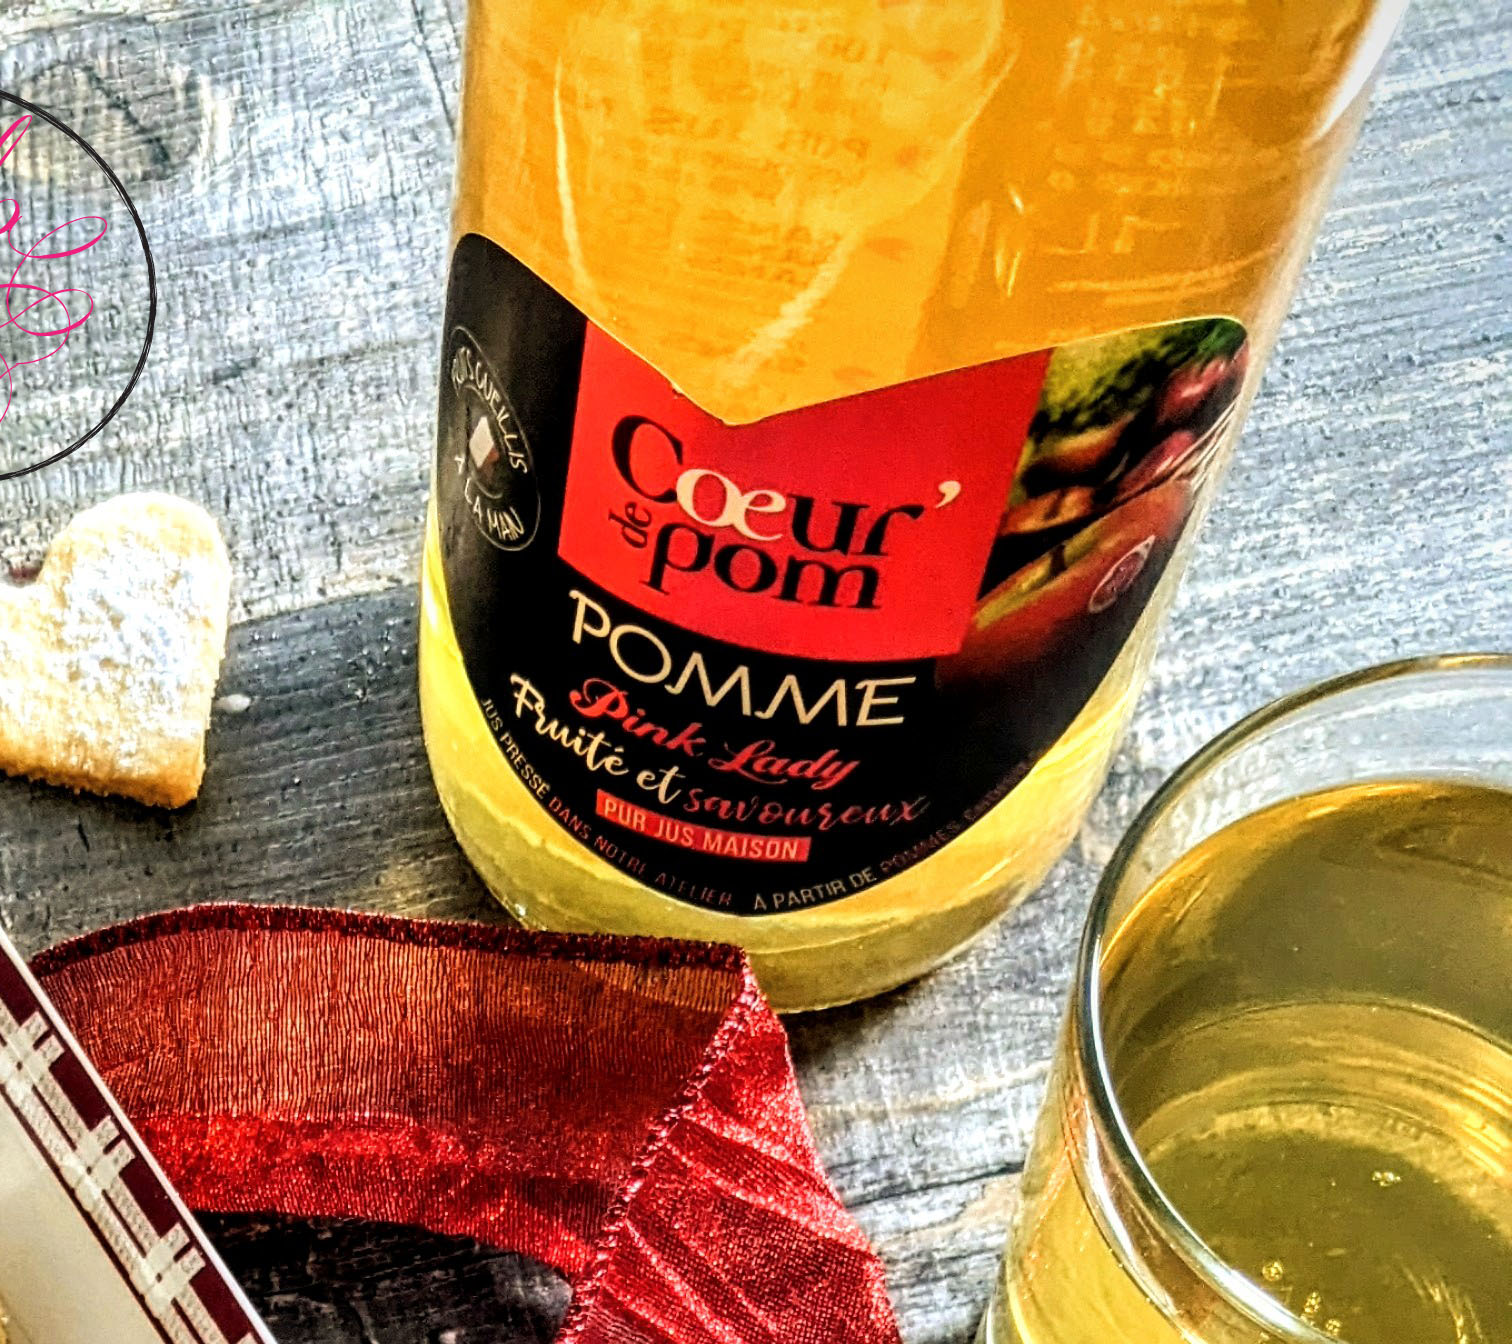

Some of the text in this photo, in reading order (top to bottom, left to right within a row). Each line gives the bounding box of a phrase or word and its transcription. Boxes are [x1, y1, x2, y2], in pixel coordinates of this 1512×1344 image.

[608, 501, 652, 550] de
[569, 589, 917, 728] POMME
[480, 698, 504, 732] JUS
[548, 797, 592, 840] DANS
[509, 672, 928, 831] Fruité et savoureux
[569, 677, 861, 791] Pink Lady
[603, 797, 799, 861] PUR JUS MAISON
[771, 879, 847, 910] PARTIR
[848, 866, 878, 889] DE
